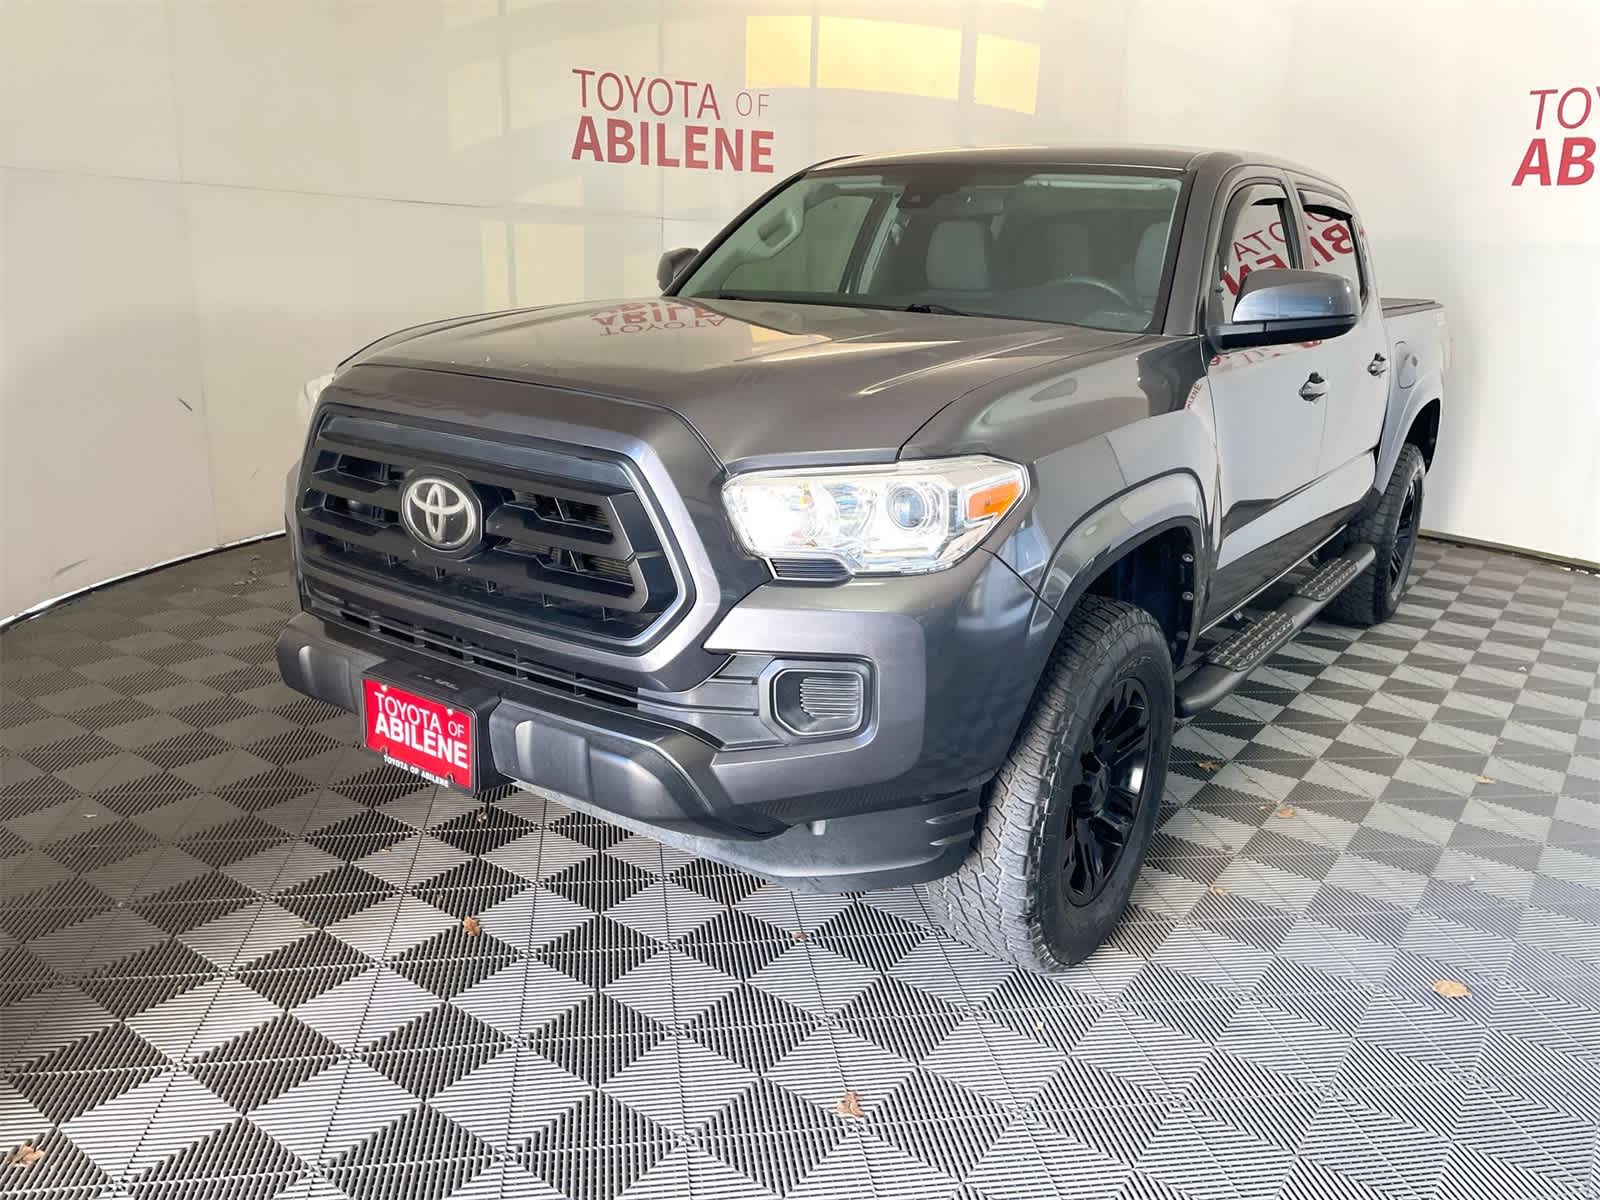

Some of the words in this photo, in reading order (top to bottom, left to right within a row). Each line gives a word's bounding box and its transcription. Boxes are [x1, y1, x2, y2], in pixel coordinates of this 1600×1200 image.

[572, 68, 721, 120] TOYOTA
[736, 92, 770, 117] OF
[1530, 86, 1600, 130] TO
[571, 115, 774, 173] ABILENE
[374, 691, 442, 734] TOYOTA
[447, 720, 465, 738] OF
[374, 712, 468, 769] ABILENE
[383, 754, 408, 771] TOYOTA
[410, 765, 419, 775] OF
[421, 770, 448, 788] ABILENE
